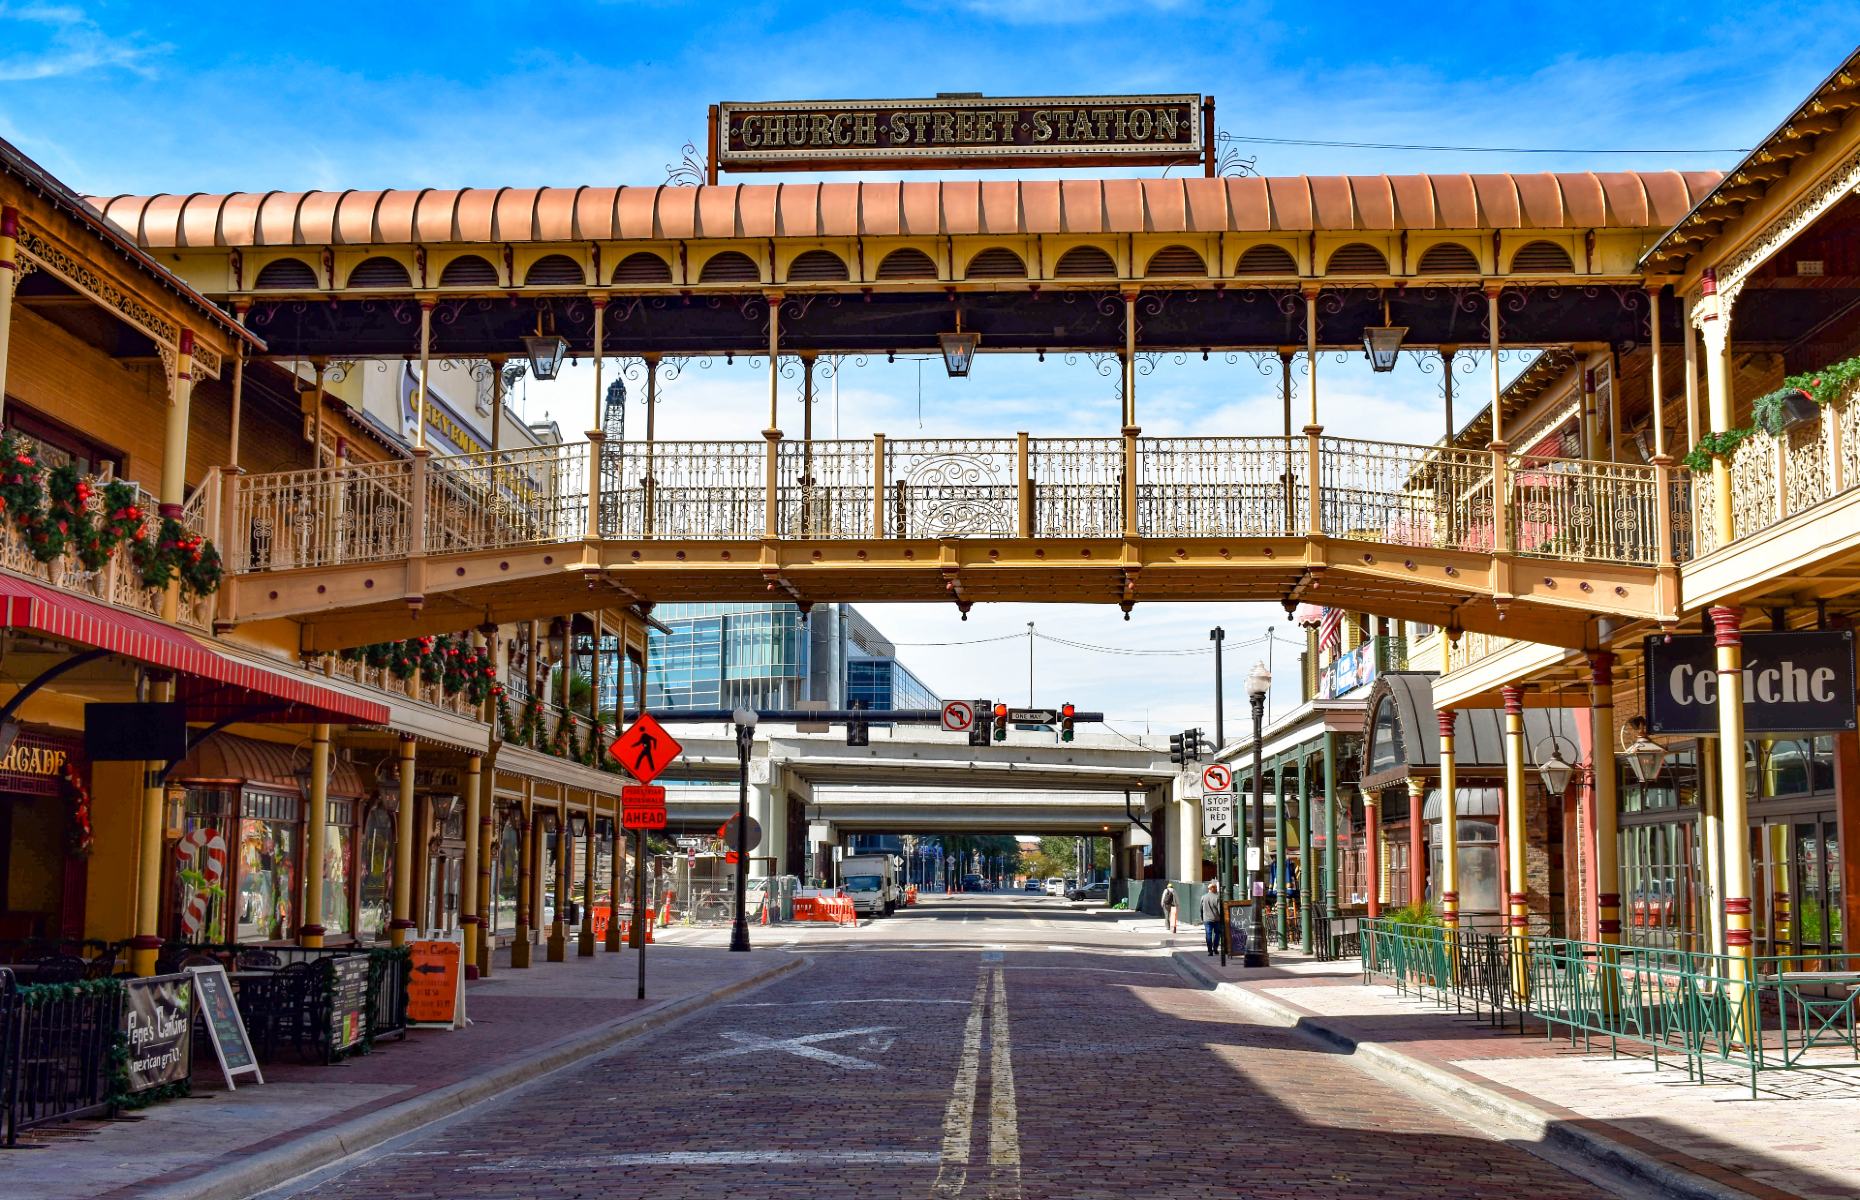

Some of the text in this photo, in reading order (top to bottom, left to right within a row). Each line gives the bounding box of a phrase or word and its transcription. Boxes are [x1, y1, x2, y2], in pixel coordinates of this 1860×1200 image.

[741, 108, 1178, 147] CHURCH STREET STATION
[1669, 659, 1836, 706] Ceíche
[0, 745, 67, 776] RCADE
[1207, 797, 1229, 805] STOP
[625, 812, 664, 824] AHEAD
[1210, 813, 1227, 821] RED
[127, 1010, 155, 1056] Pepe's
[156, 1005, 188, 1039] Cantina
[133, 1046, 181, 1074] mexican grill
